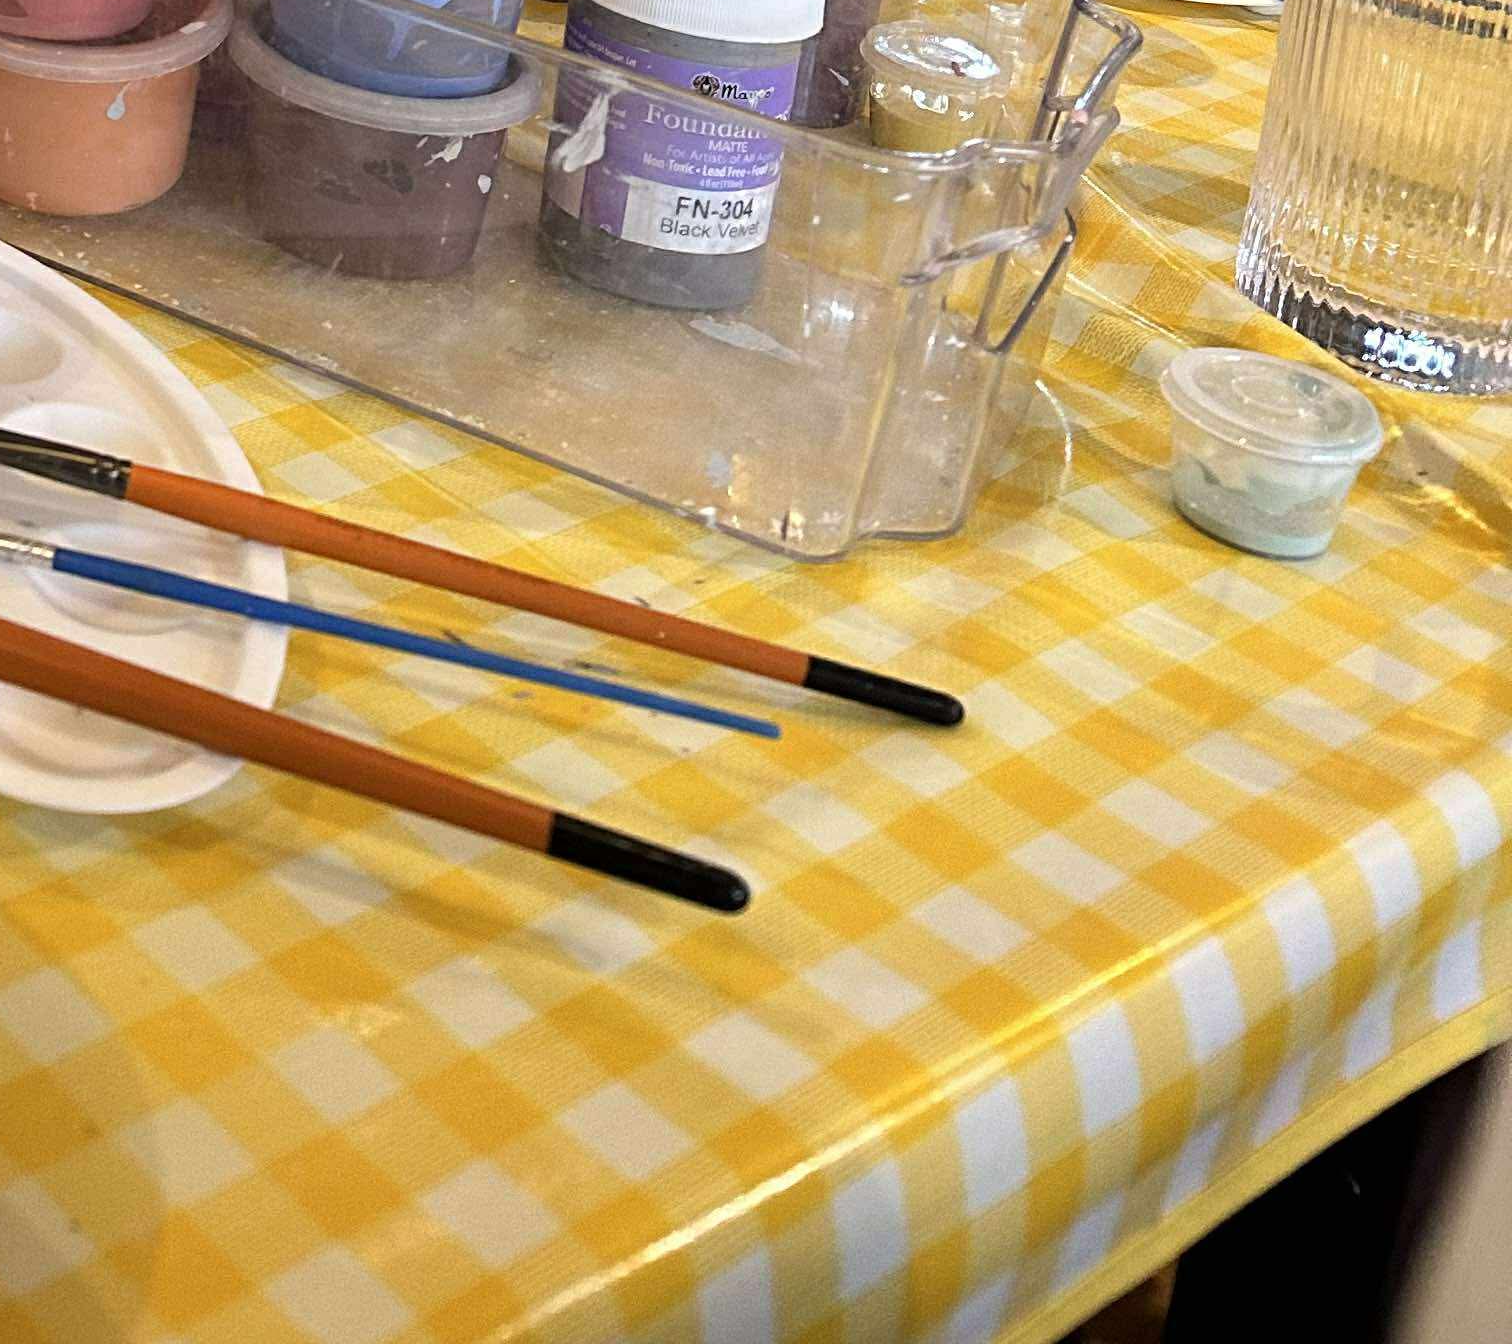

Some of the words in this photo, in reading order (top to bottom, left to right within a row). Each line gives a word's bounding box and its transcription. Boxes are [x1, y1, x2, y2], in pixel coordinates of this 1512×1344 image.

[708, 139, 749, 153] MATTE
[675, 196, 754, 220] FN-304
[660, 216, 711, 238] Black
[717, 222, 761, 239] Velvet
